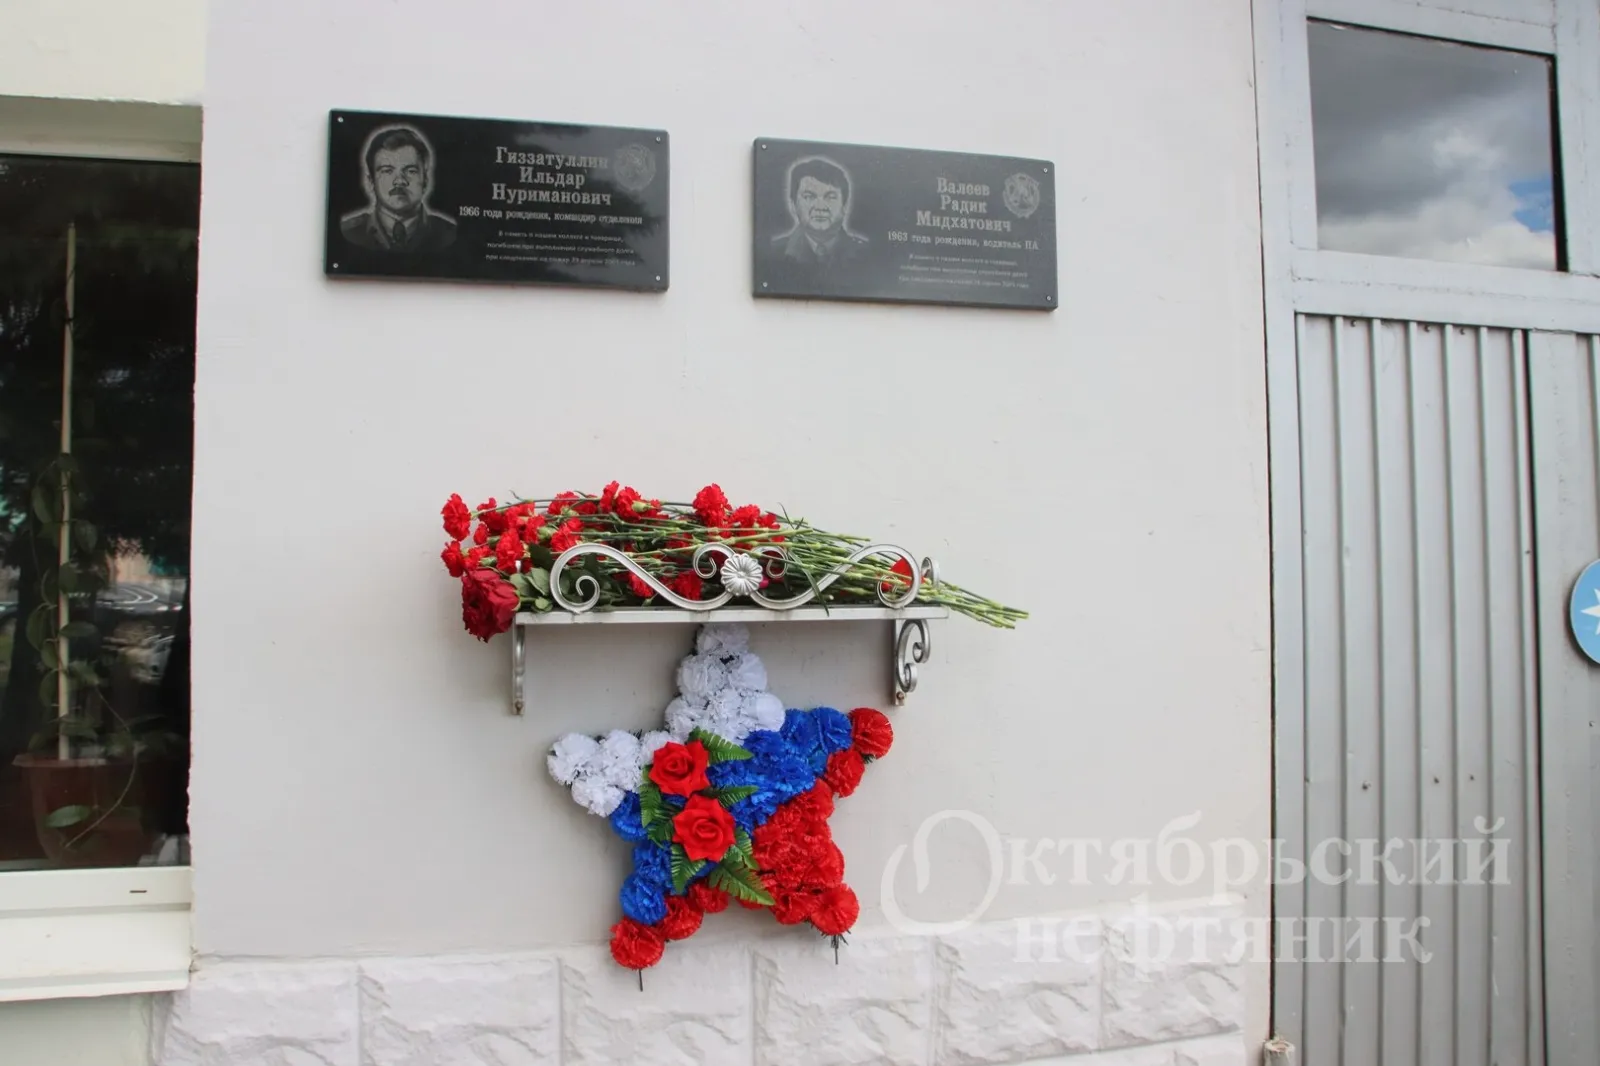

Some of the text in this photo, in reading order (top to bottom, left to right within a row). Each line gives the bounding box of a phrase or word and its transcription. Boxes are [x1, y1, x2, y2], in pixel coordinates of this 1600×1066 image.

[495, 146, 611, 169] Гиззатуллин
[519, 166, 586, 189] Ильдар
[936, 176, 991, 197] Валеев
[491, 182, 612, 206] Нуриманович
[458, 205, 643, 225] 1966 года рождения, командир отделения
[940, 195, 988, 215] Радик
[915, 210, 1012, 232] Мидхатович
[887, 230, 1039, 250] 1963 года рождения, водитель ПА
